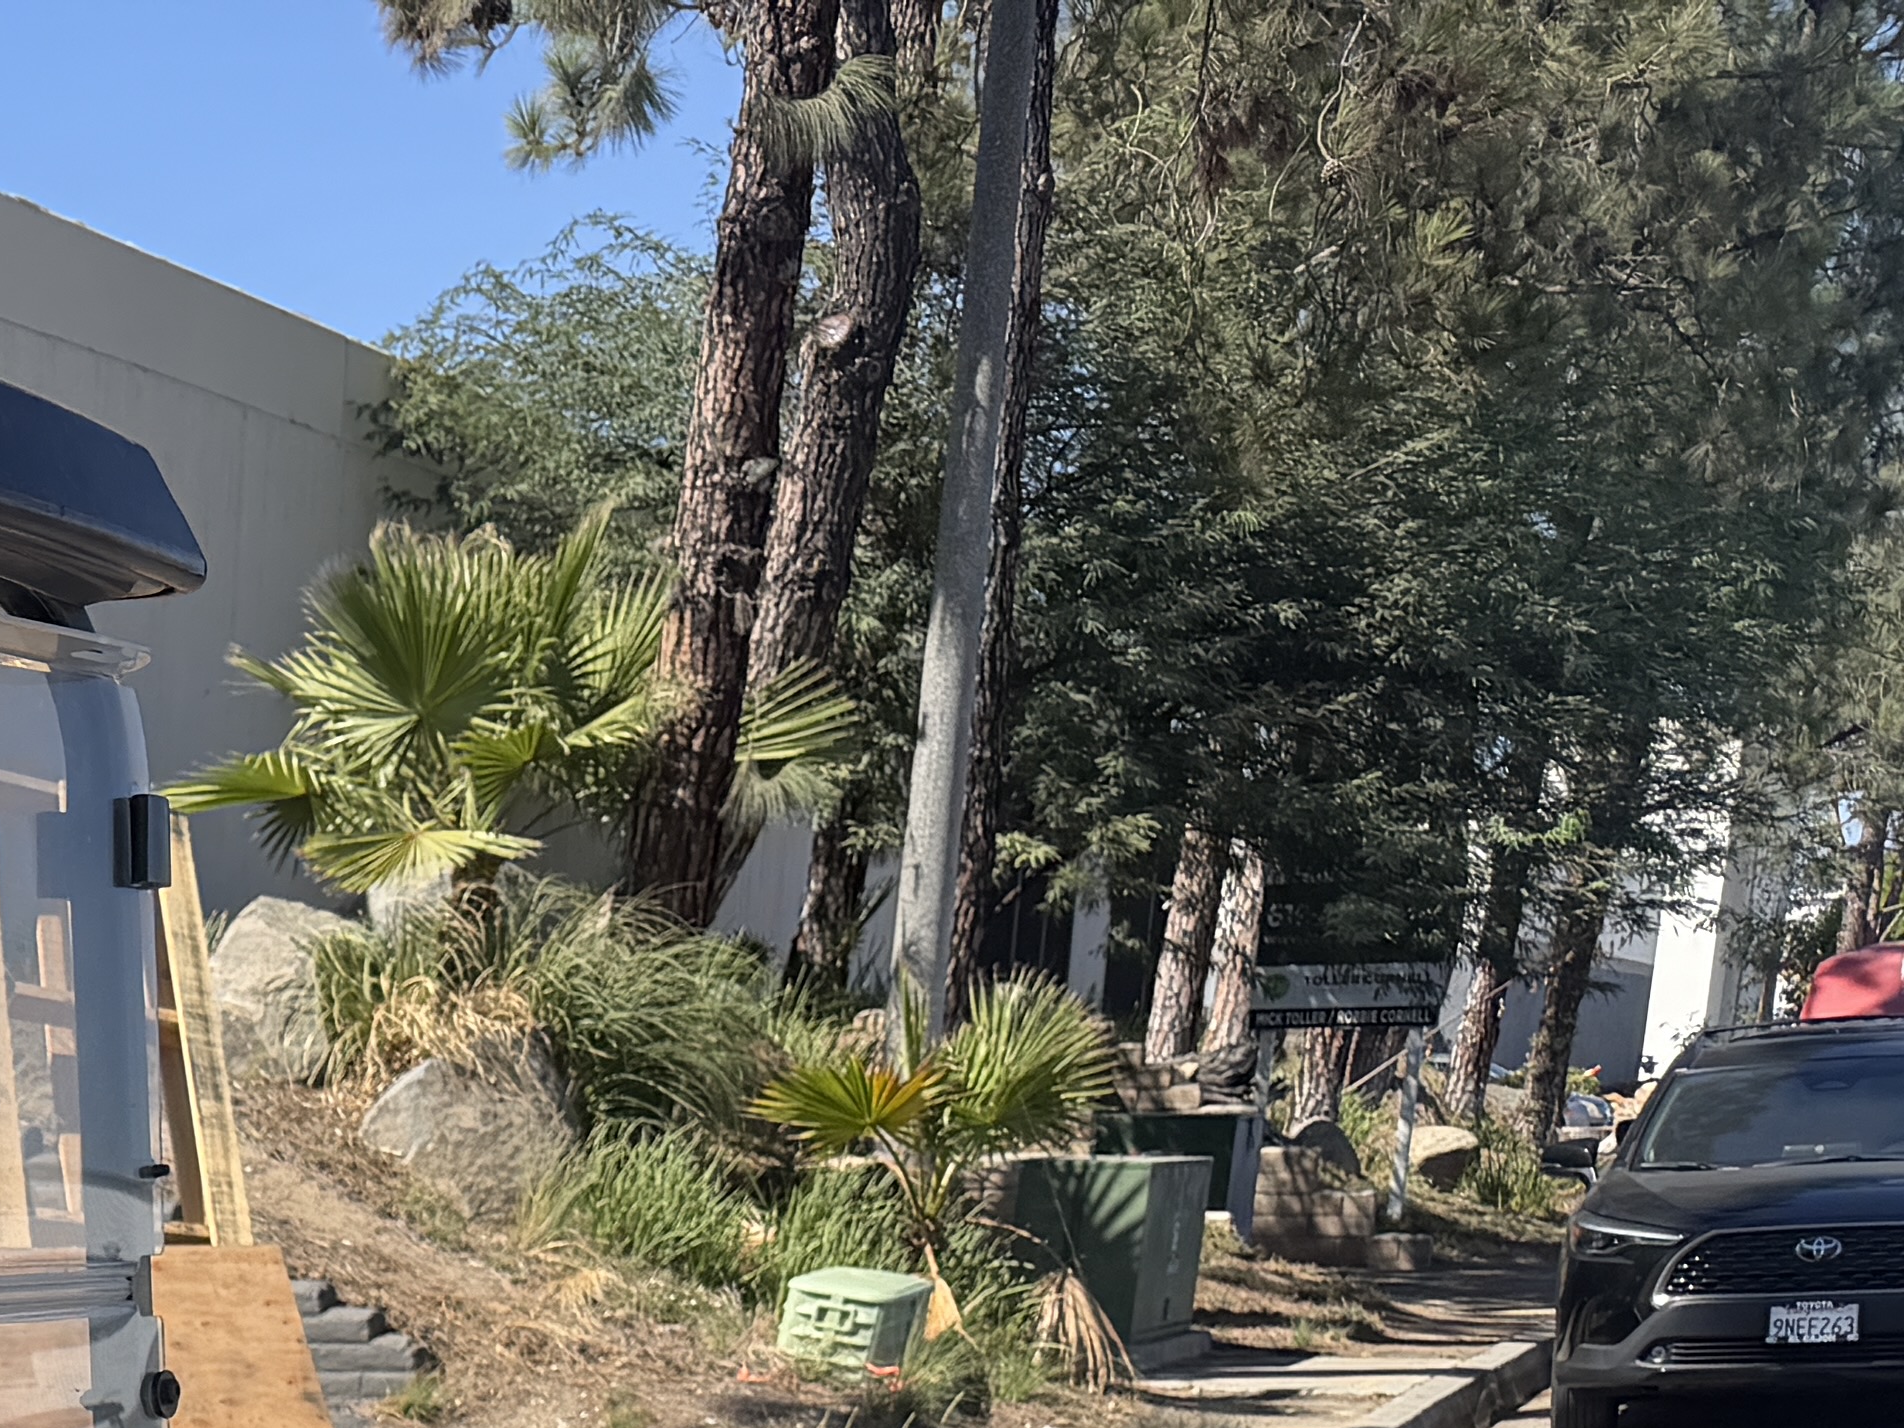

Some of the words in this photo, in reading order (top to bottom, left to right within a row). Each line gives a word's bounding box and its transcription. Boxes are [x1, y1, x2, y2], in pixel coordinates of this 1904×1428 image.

[1286, 1011, 1326, 1025] TOLLER
[1380, 1009, 1430, 1023] CORNELL
[1796, 1301, 1833, 1311] TOYOTA
